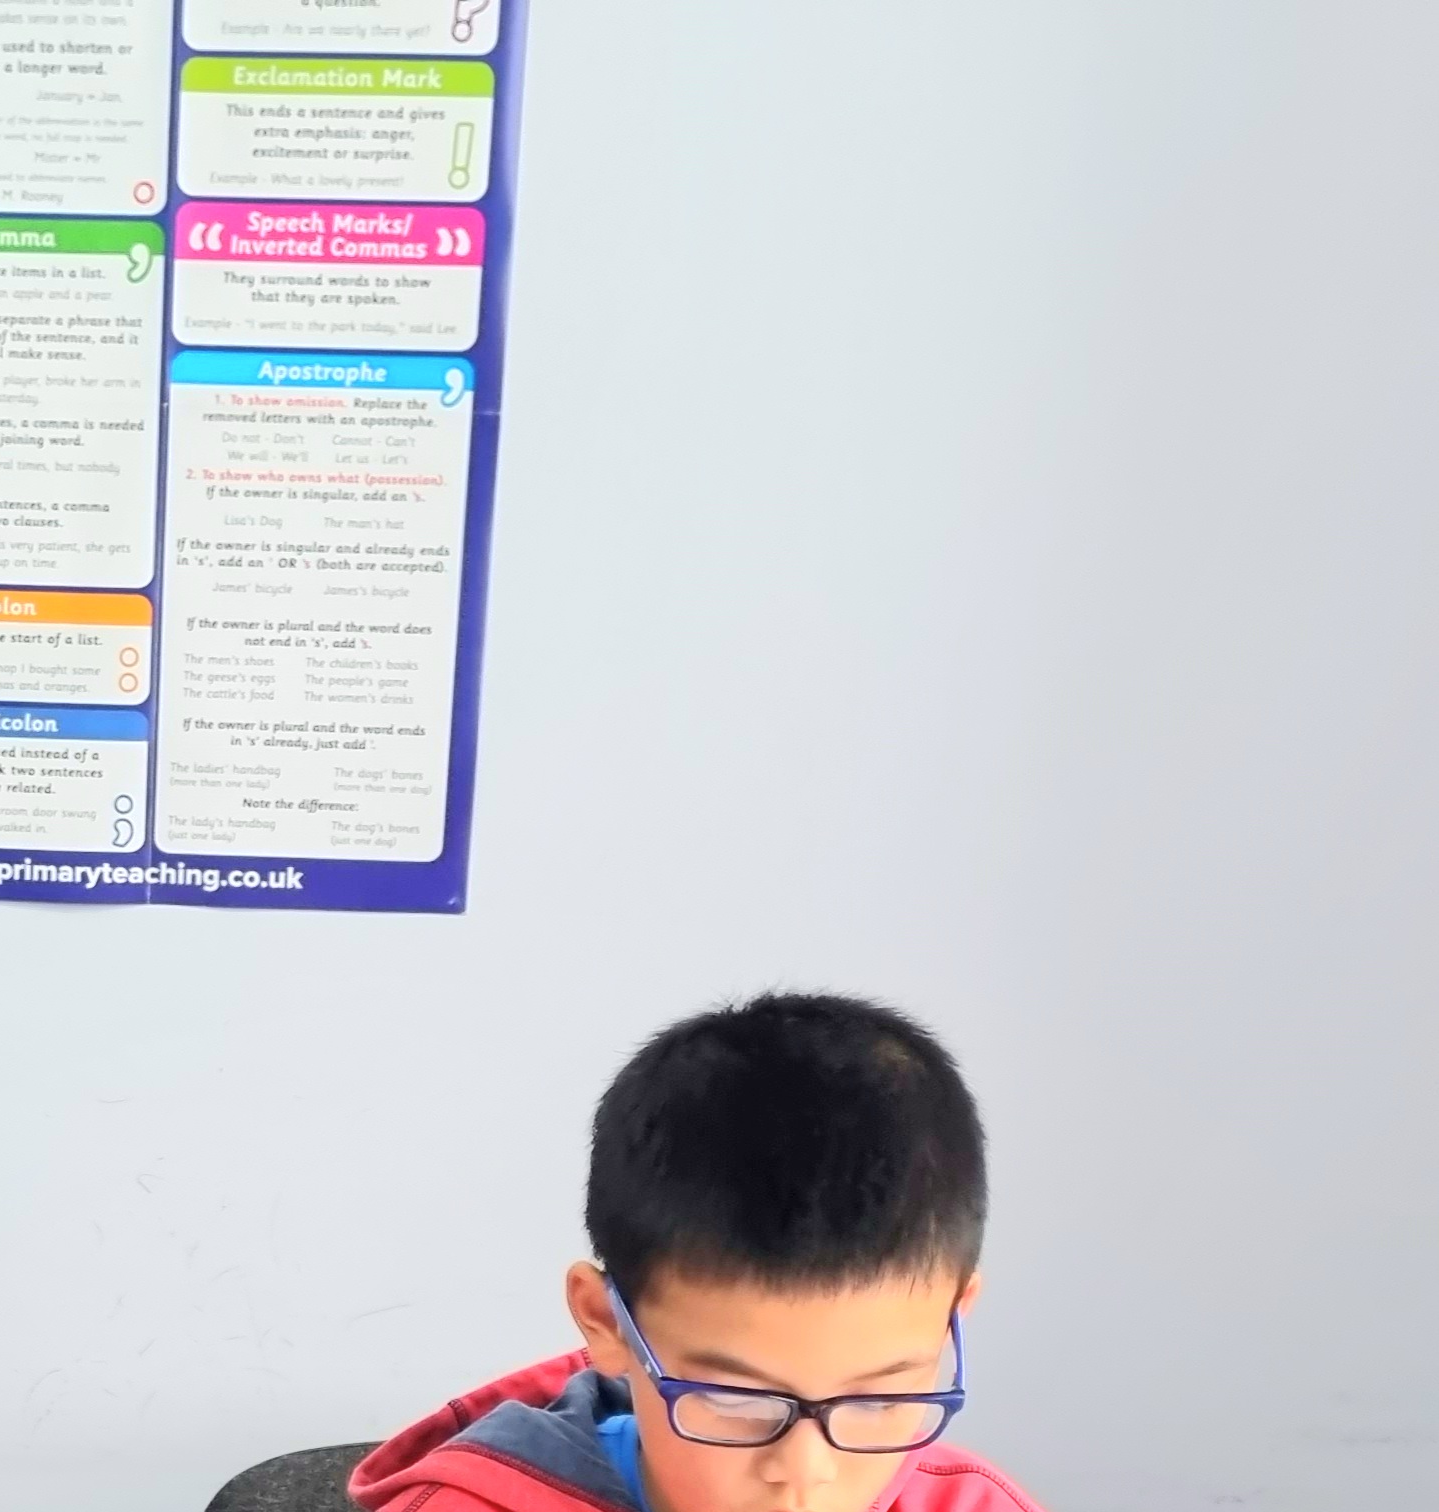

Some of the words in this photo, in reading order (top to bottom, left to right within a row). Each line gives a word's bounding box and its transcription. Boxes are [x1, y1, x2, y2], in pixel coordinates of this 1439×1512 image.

[233, 66, 373, 87] Exclamation
[382, 69, 442, 89] Mark
[248, 212, 324, 235] Speech
[332, 214, 414, 236] Marks/
[230, 236, 323, 256] Inverted
[330, 237, 427, 259] Commas
[12, 266, 47, 278] items
[52, 267, 63, 278] in
[69, 270, 76, 278] a
[81, 267, 106, 279] list.
[258, 361, 387, 386] Apostrophe
[11, 633, 42, 645] start
[48, 633, 61, 648] of
[65, 636, 72, 645] a
[78, 634, 103, 646] list.
[21, 748, 69, 760] instead
[74, 749, 88, 763] of
[92, 752, 99, 761] a
[11, 766, 35, 776] two
[40, 767, 103, 779] sentences
[7, 782, 56, 794] related.
[243, 798, 270, 808] Note
[275, 799, 294, 810] the
